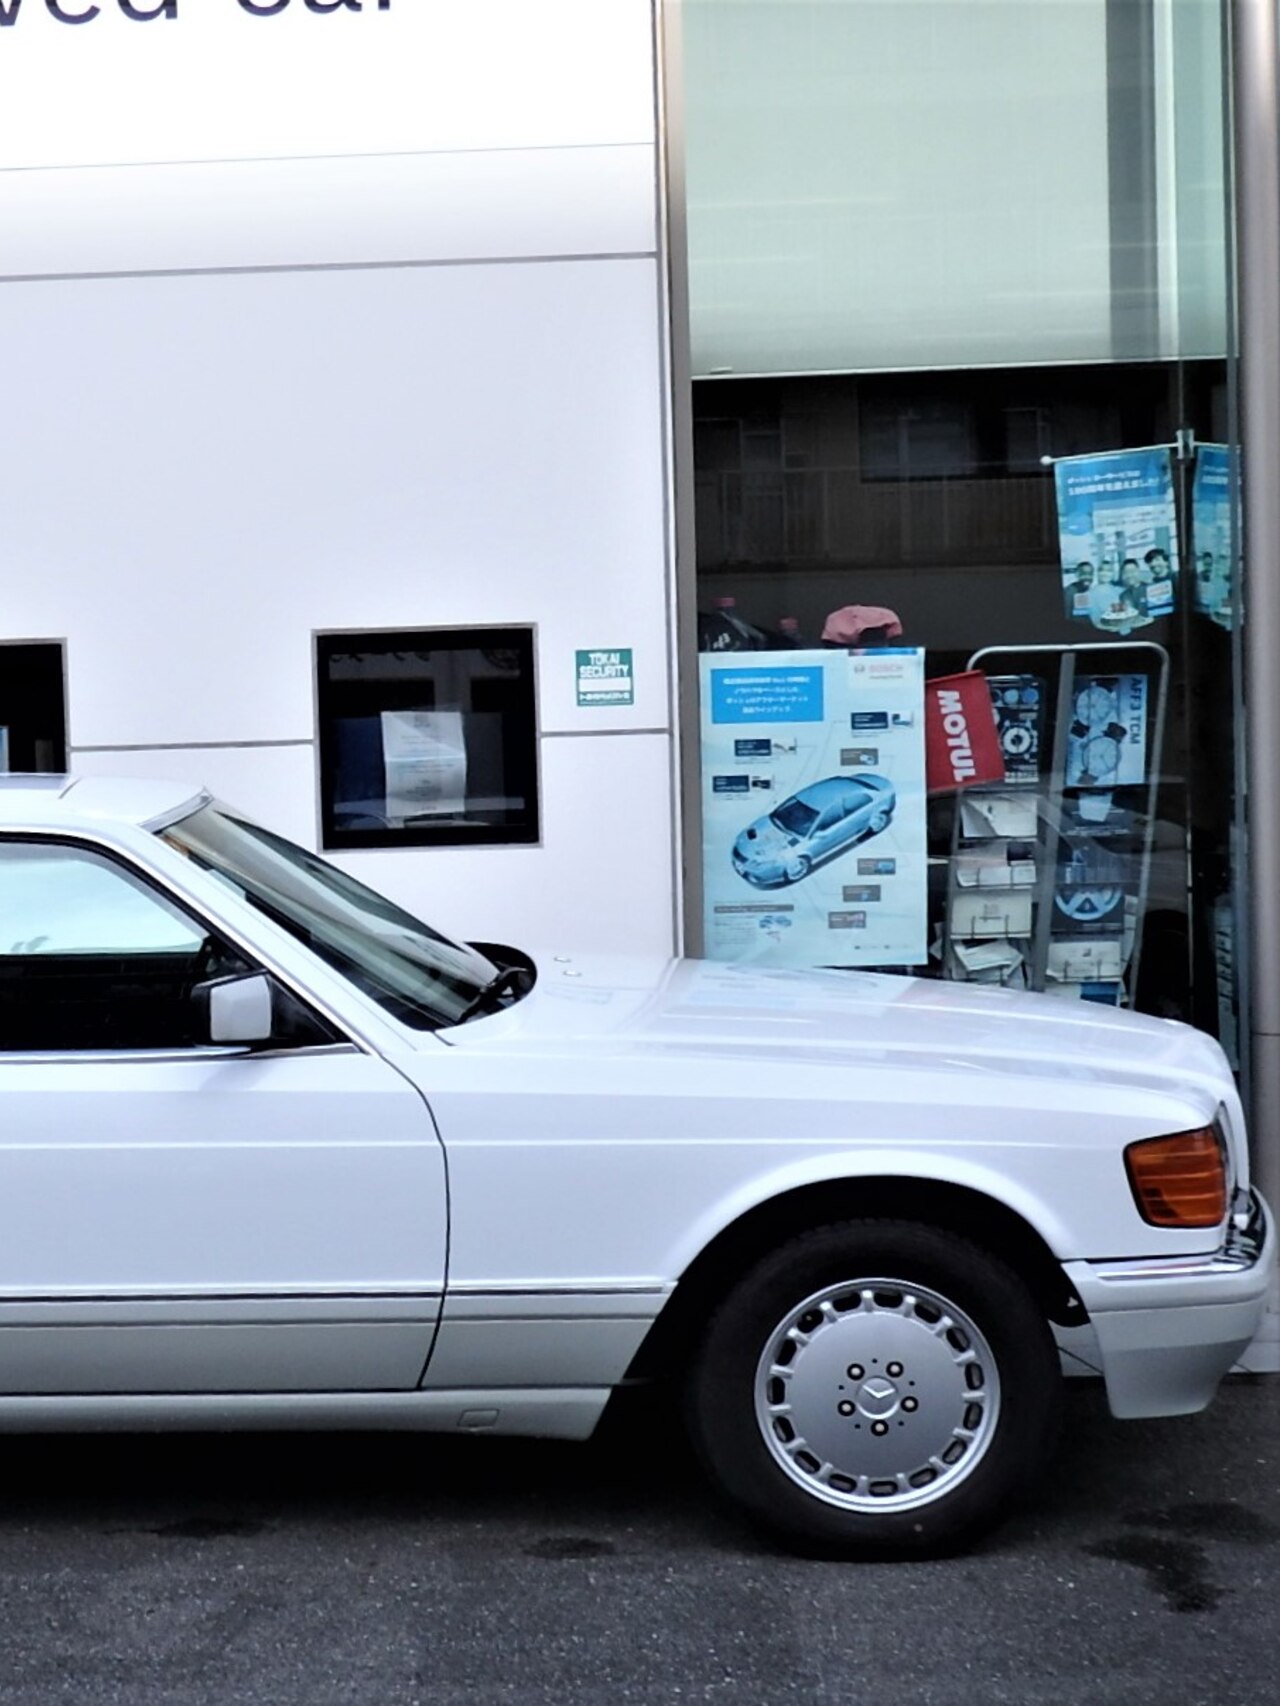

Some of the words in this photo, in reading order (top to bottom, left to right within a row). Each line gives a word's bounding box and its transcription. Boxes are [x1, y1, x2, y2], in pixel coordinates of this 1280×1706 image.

[588, 652, 621, 665] TOKAI
[579, 664, 629, 678] SECURITY
[936, 689, 976, 783] MOTUL
[1128, 716, 1142, 744] TCM
